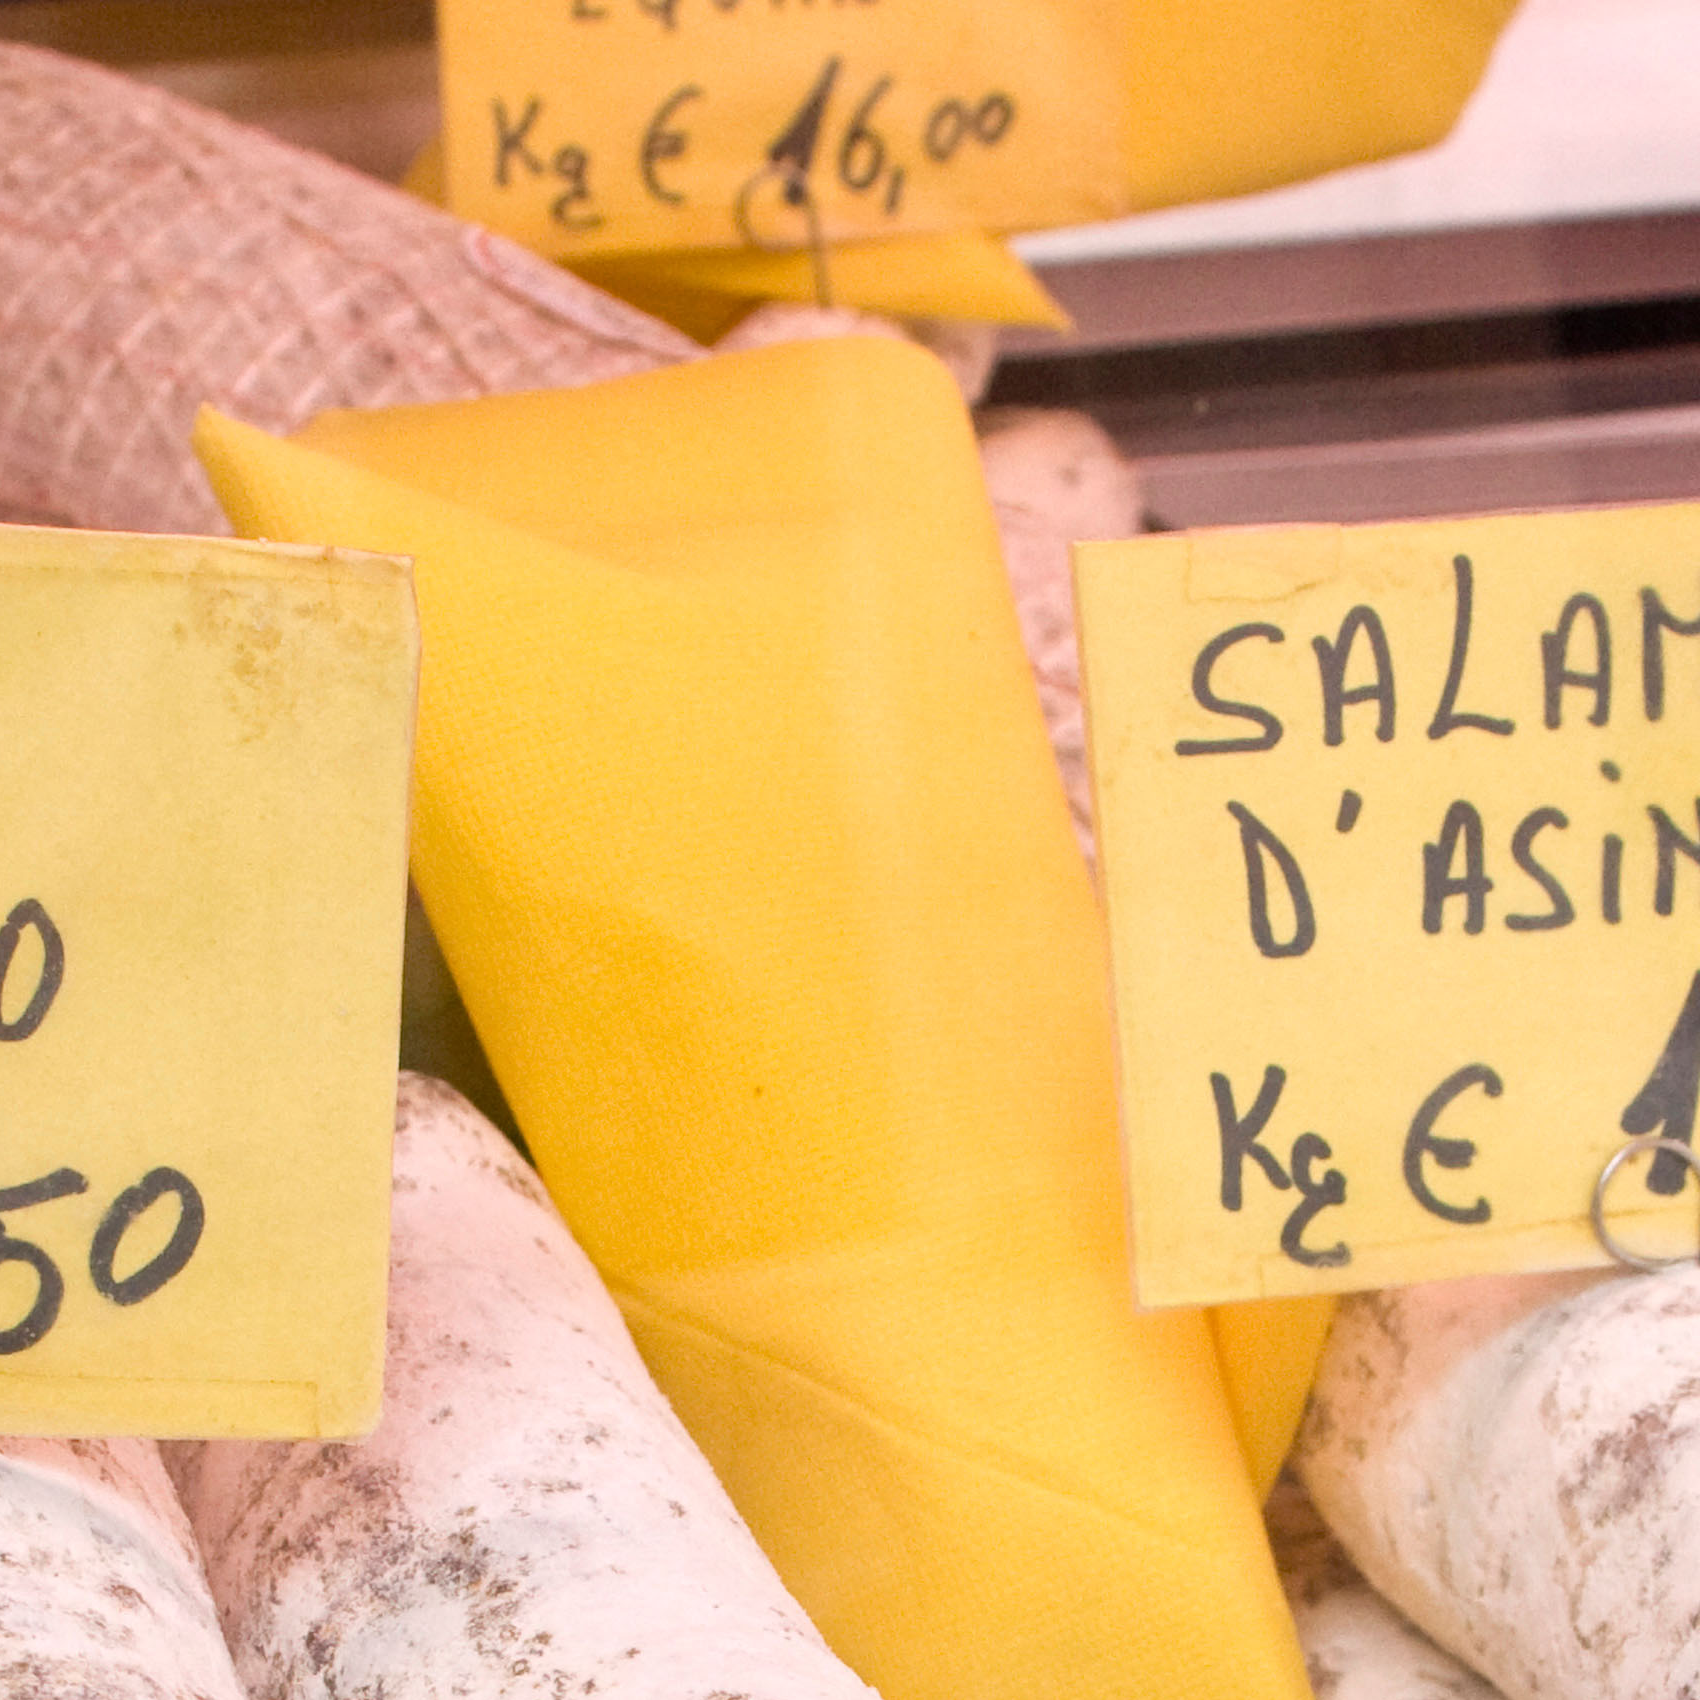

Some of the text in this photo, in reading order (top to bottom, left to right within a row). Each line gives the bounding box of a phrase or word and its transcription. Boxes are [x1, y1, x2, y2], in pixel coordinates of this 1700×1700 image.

[490, 56, 1016, 230] Kg € 16,00
[1209, 1064, 1351, 1267] Kg
[1402, 1062, 1504, 1225] €
